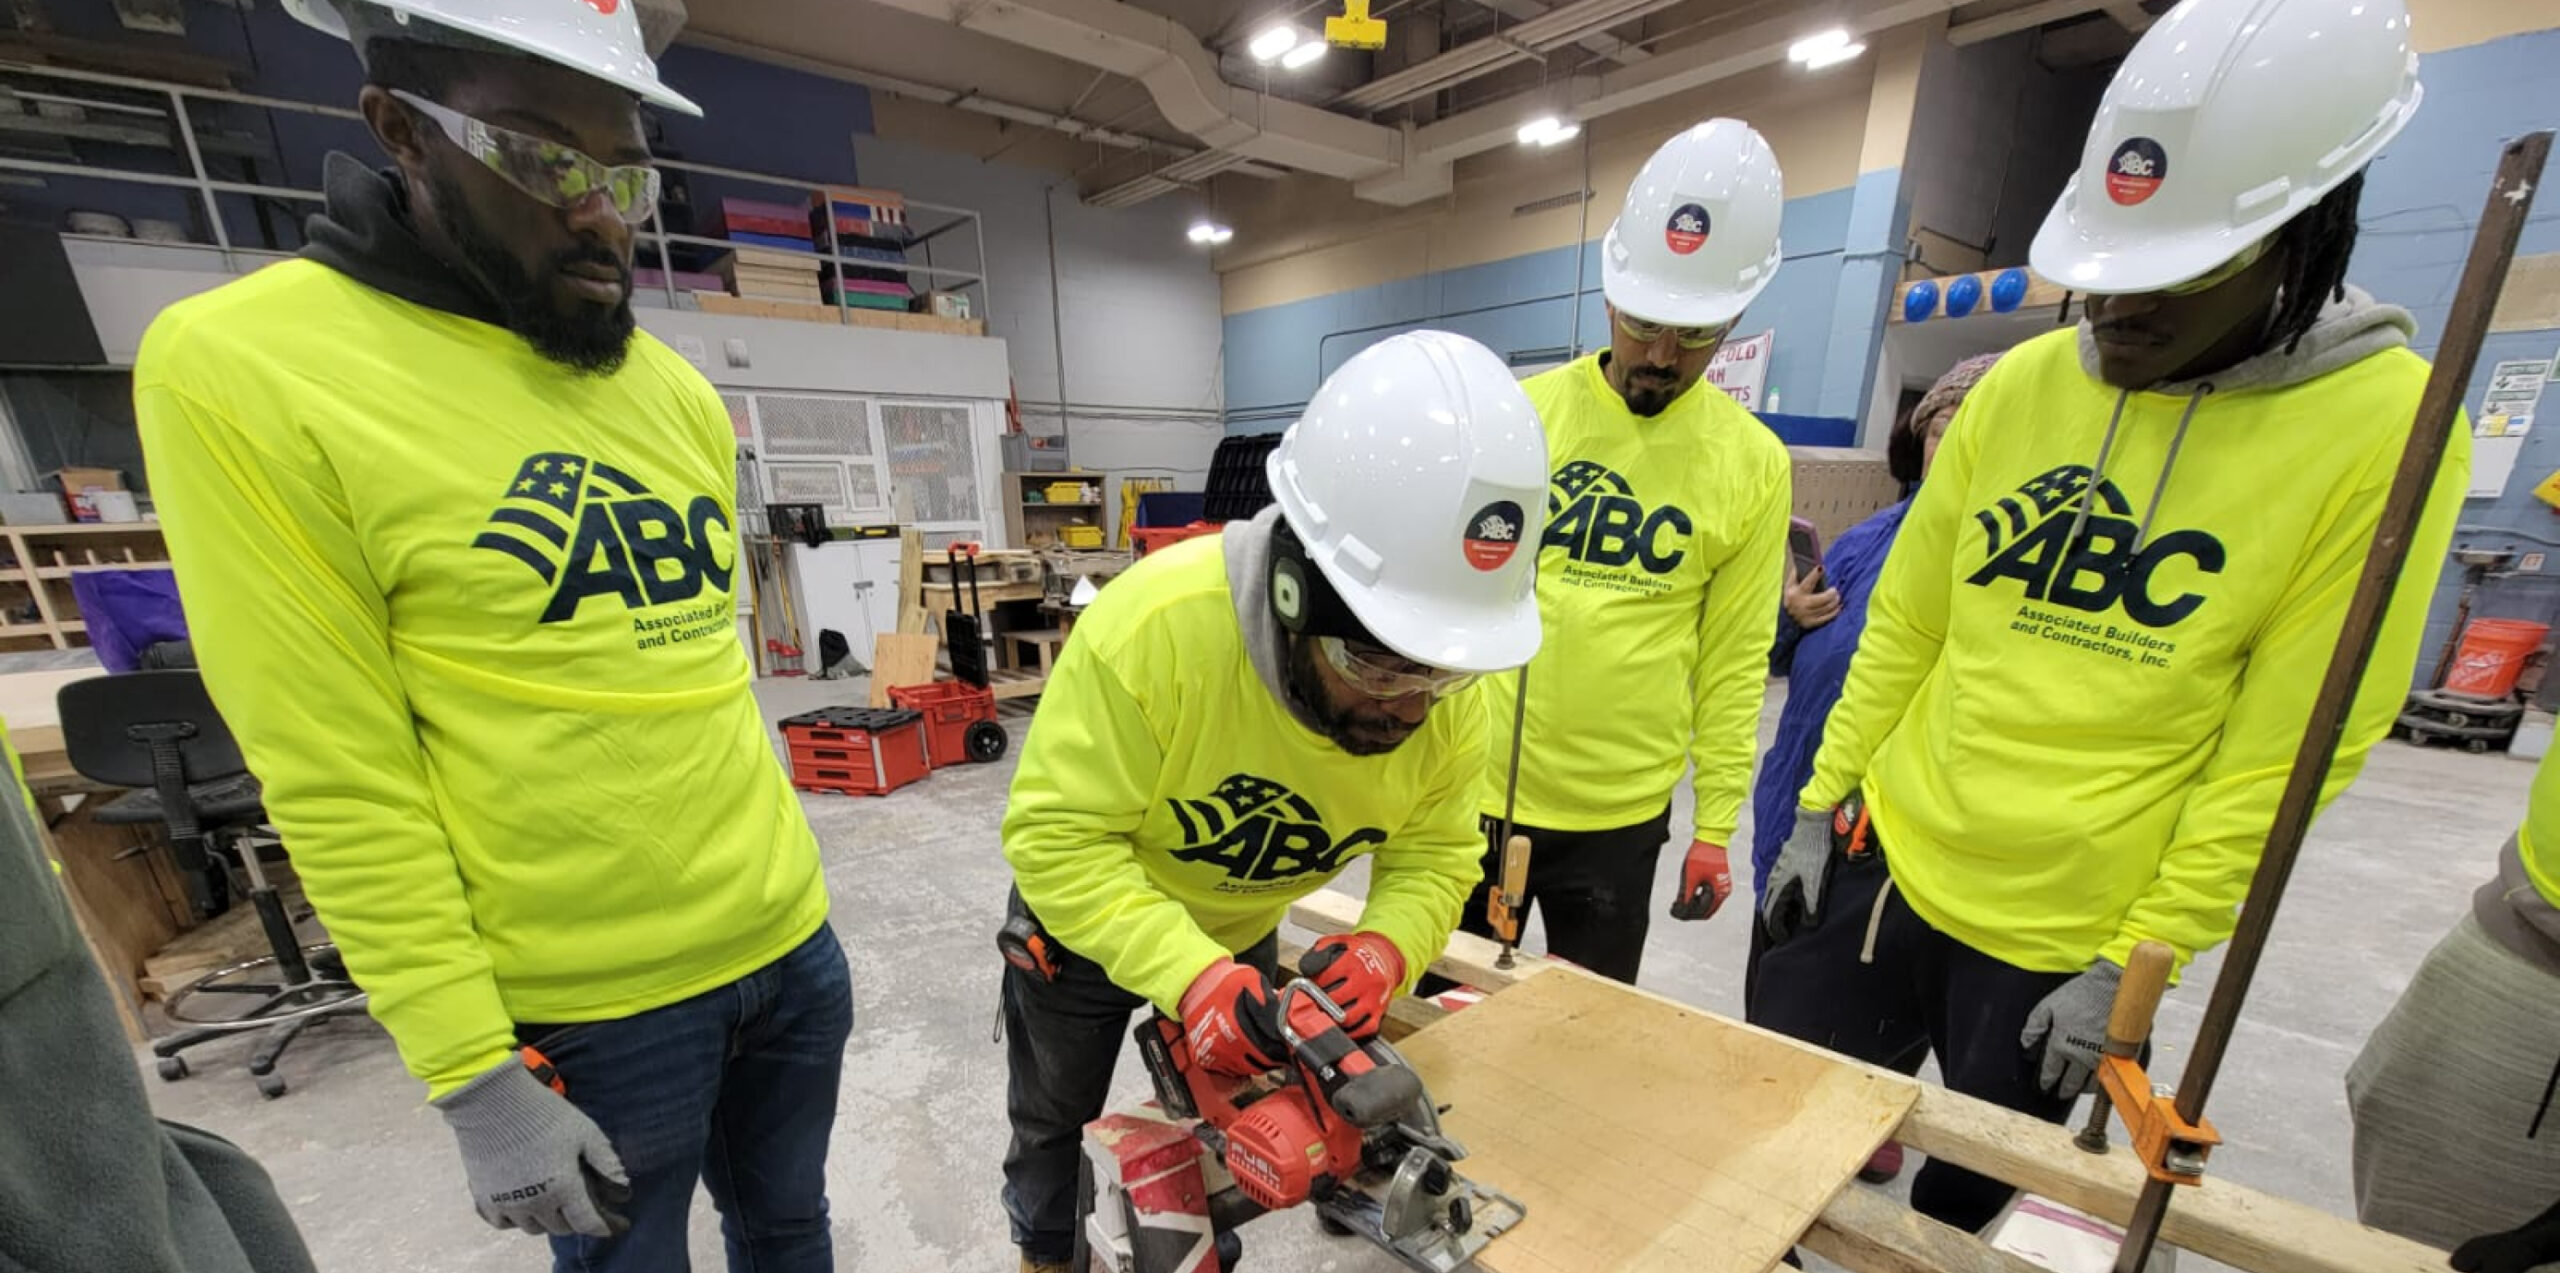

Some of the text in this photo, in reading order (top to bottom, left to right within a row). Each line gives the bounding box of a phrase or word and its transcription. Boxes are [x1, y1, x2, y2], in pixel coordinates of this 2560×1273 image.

[538, 495, 735, 624] ABC
[1537, 494, 1693, 575] ABC
[1563, 565, 1628, 582] Associated
[1965, 509, 2227, 628] ABC
[634, 604, 713, 632] Associated
[638, 631, 667, 649] and
[2017, 605, 2177, 654] Associated Builders
[2010, 619, 2171, 669] and Contractors, Inc.
[1168, 815, 1388, 881] ABC
